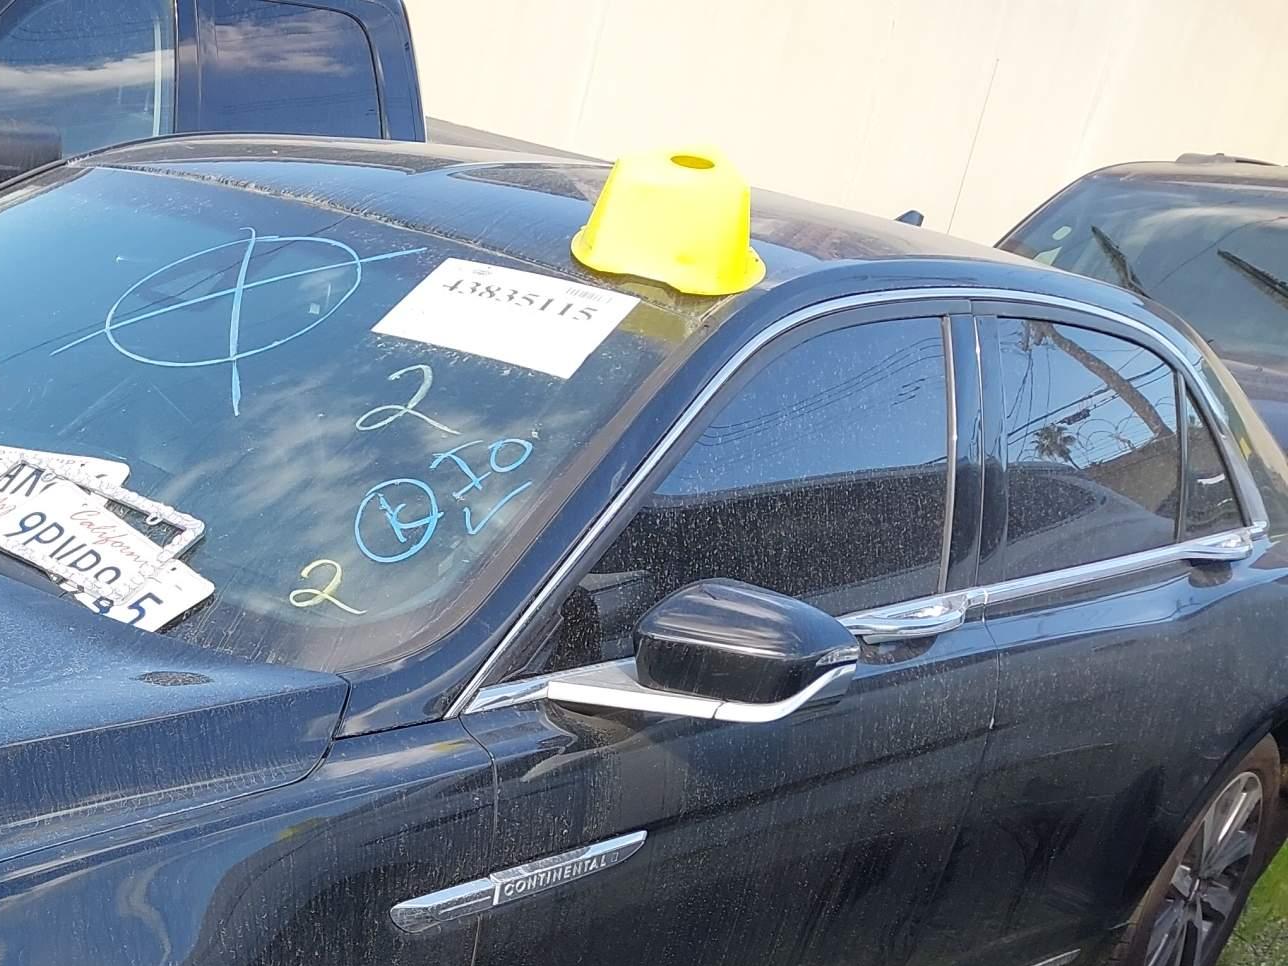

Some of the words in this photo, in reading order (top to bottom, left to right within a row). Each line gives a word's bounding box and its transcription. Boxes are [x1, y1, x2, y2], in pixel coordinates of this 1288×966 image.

[442, 279, 598, 321] 43835115
[355, 364, 461, 435] 2
[289, 558, 367, 614] 2
[503, 854, 607, 897] CONTINENTAL
